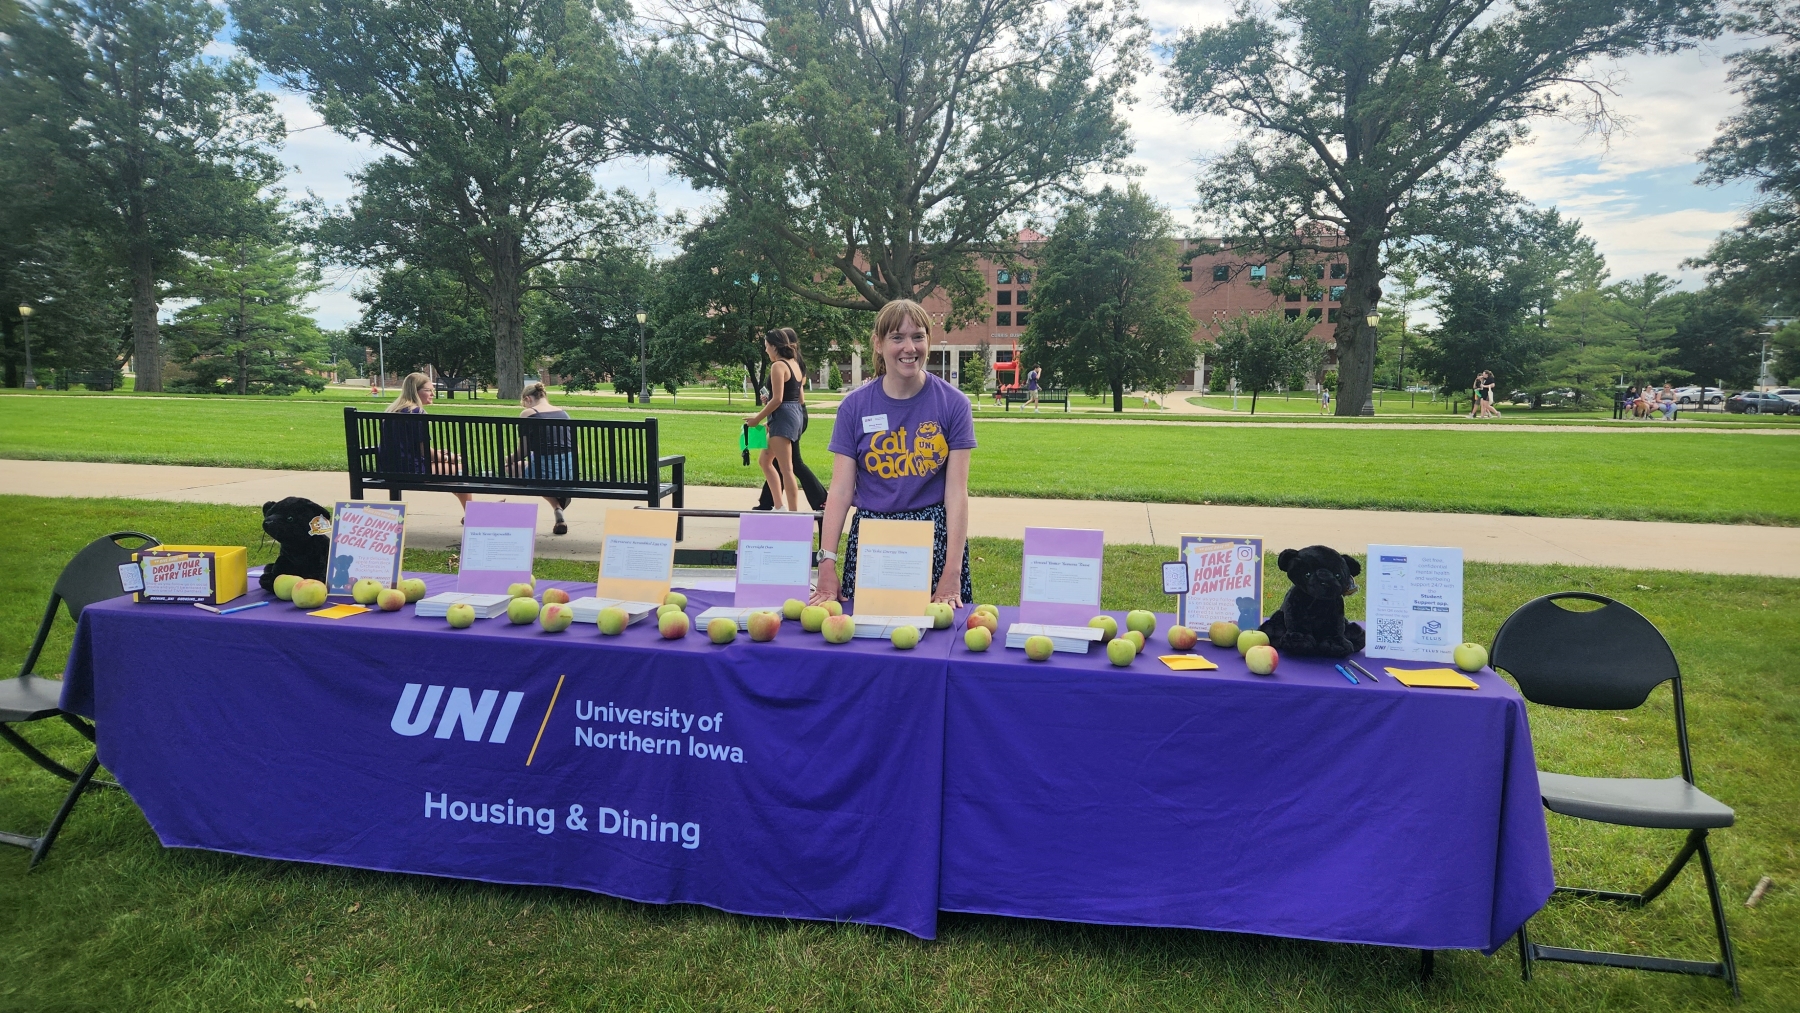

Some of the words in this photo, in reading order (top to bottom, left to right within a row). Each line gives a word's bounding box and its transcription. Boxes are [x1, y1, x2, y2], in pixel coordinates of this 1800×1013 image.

[870, 426, 907, 455] Cat
[919, 441, 935, 451] UNI
[342, 511, 364, 524] UNI
[364, 517, 404, 534] DINING
[349, 525, 390, 542] SERVES
[334, 533, 368, 549] LOCAL
[368, 541, 398, 556] FOOD
[153, 563, 175, 574] DROP
[177, 559, 200, 570] YOUR
[1201, 550, 1232, 567] TAKE
[154, 571, 179, 582] ENTRY
[182, 567, 202, 578] HERE
[1193, 564, 1230, 581] HOME
[1235, 562, 1244, 575] A
[1191, 575, 1252, 595] PANTHER
[390, 682, 524, 744] UNI
[575, 700, 695, 734] University
[697, 711, 723, 732] of
[574, 726, 681, 755] Northern
[688, 736, 744, 764] Iowa
[424, 791, 555, 835] Housing
[565, 804, 589, 831] &
[599, 807, 700, 850] Dining
